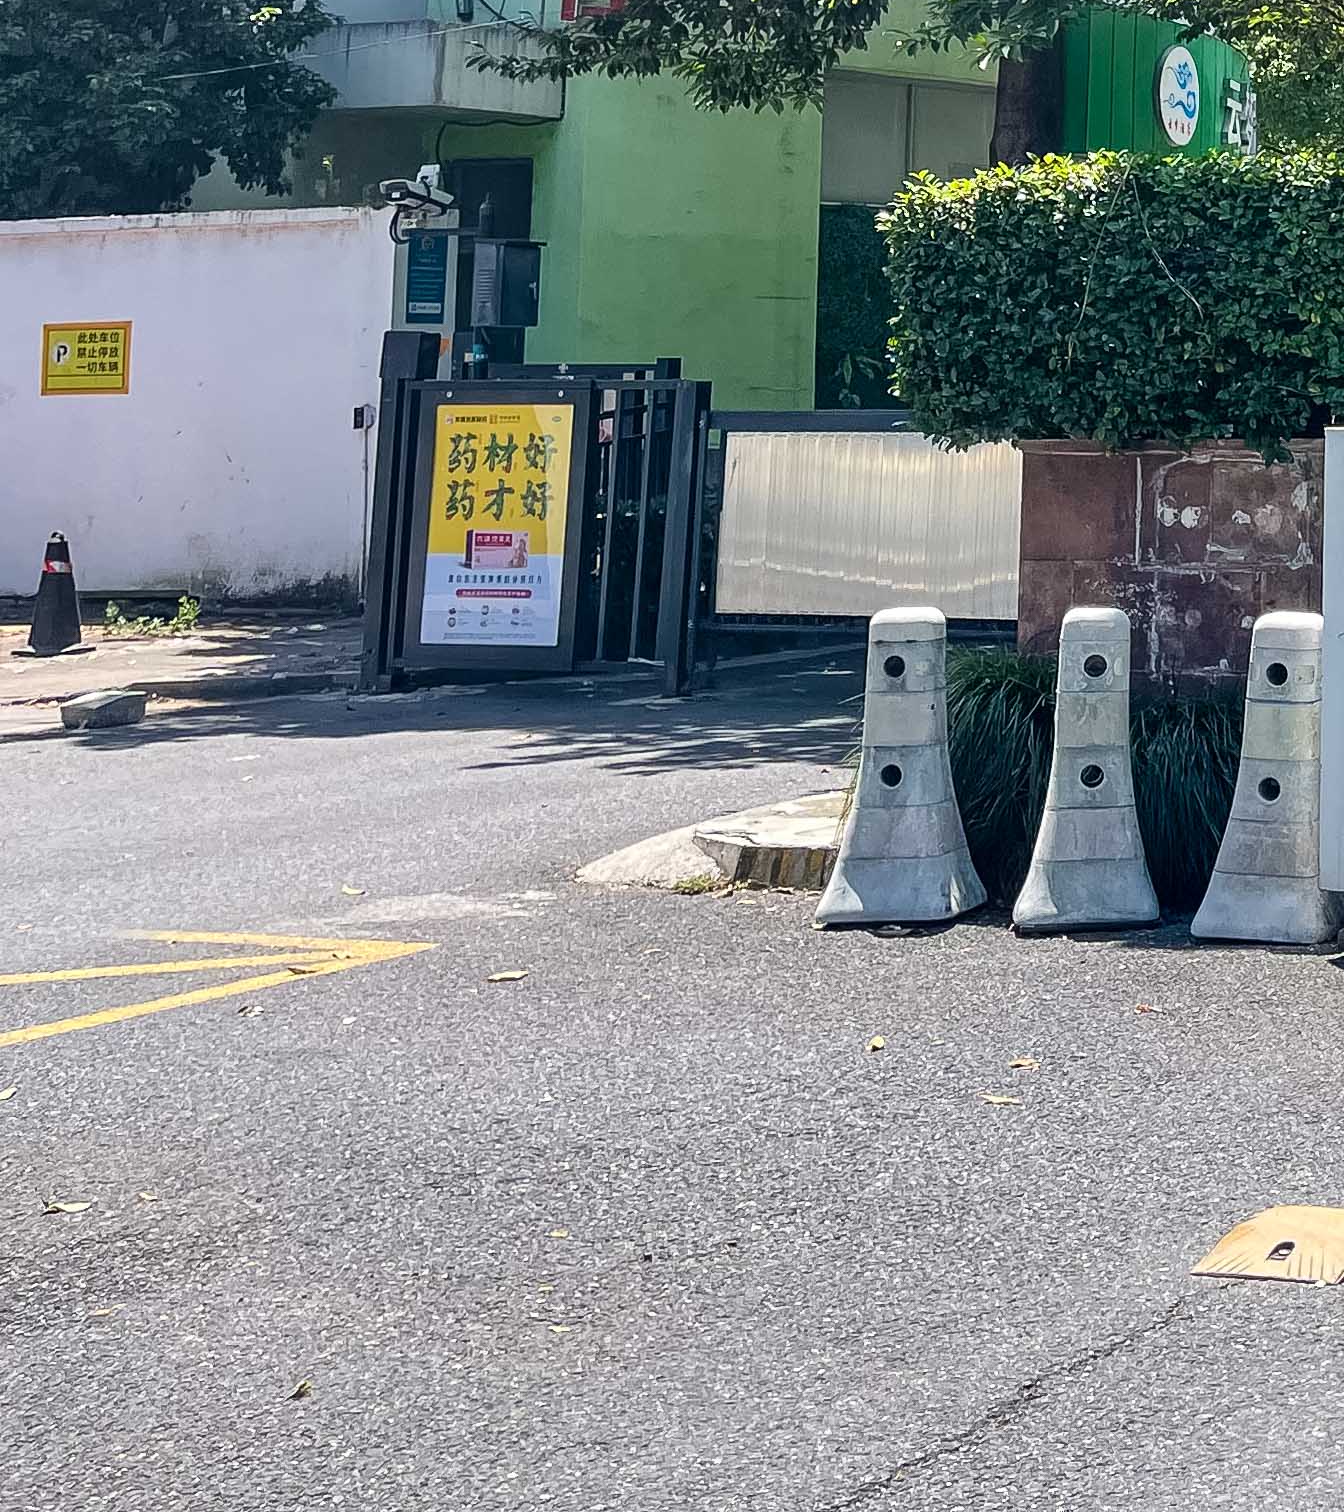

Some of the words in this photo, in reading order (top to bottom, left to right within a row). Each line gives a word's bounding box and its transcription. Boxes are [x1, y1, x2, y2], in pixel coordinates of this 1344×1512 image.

[77, 332, 120, 344] 此处车位
[77, 347, 119, 359] 禁止停放
[76, 361, 119, 374] 一切车辆
[447, 432, 558, 474] 药材好
[445, 479, 554, 522] 药才好
